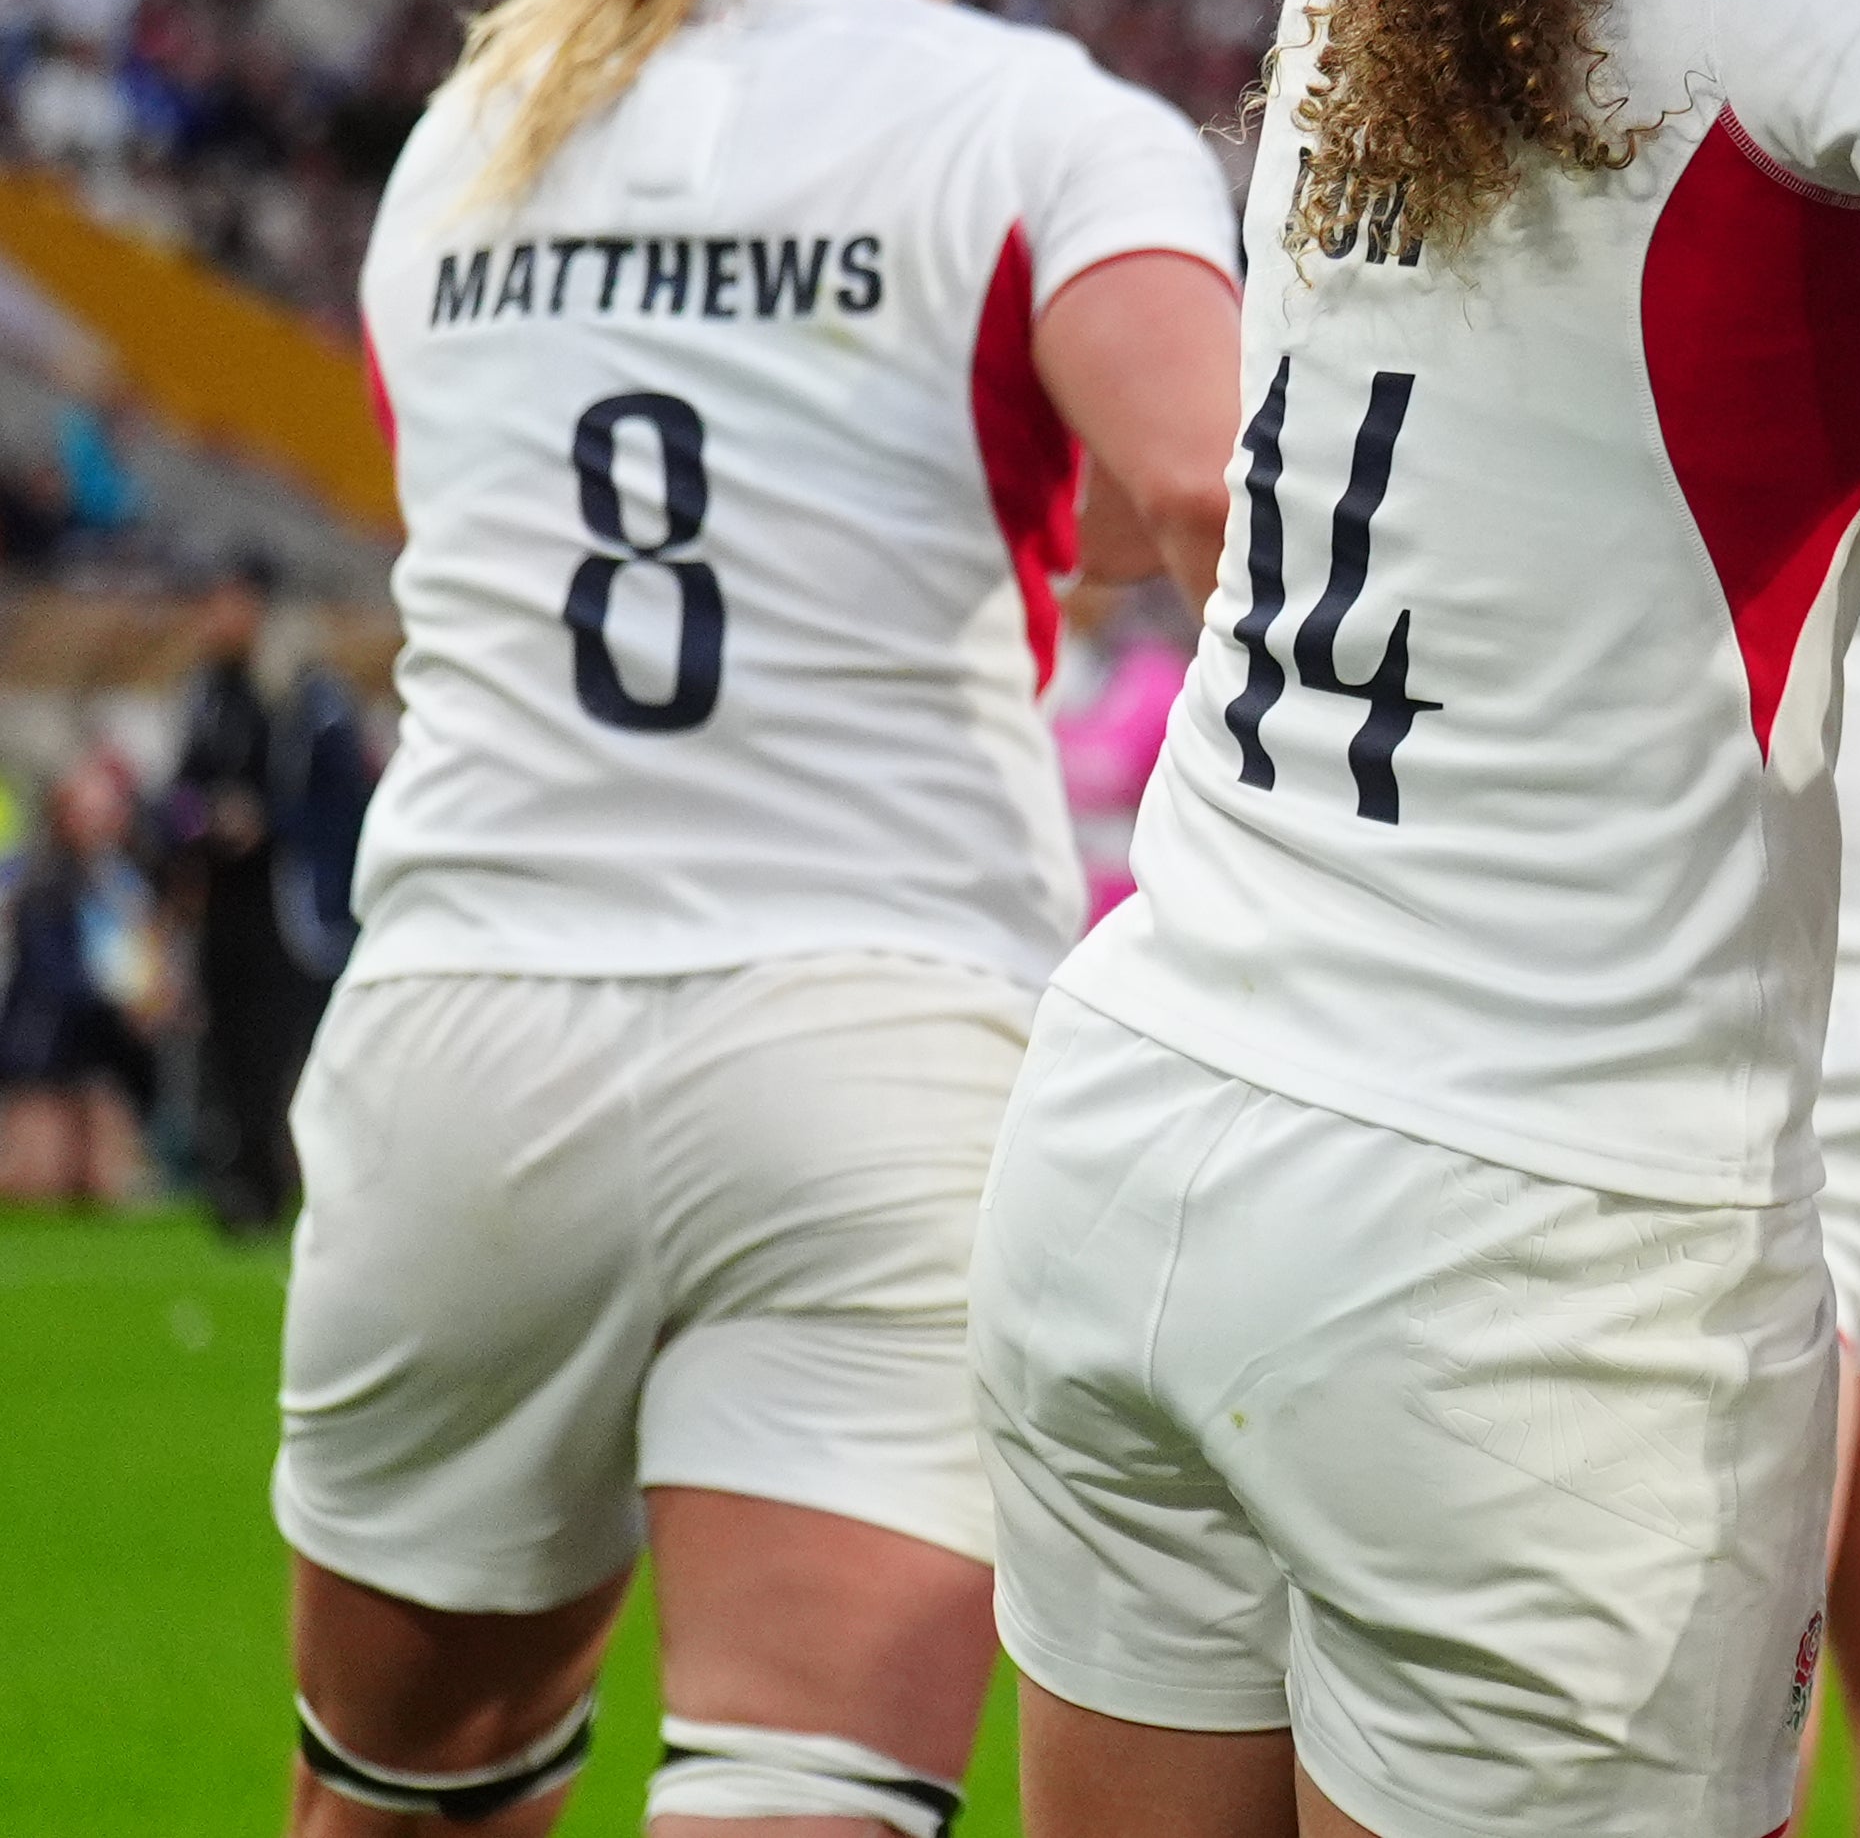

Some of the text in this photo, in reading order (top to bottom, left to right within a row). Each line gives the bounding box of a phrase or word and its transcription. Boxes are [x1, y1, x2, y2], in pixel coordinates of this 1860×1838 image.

[429, 233, 884, 331] MATTHEWS
[563, 392, 726, 736] 8
[1225, 356, 1443, 825] 14
